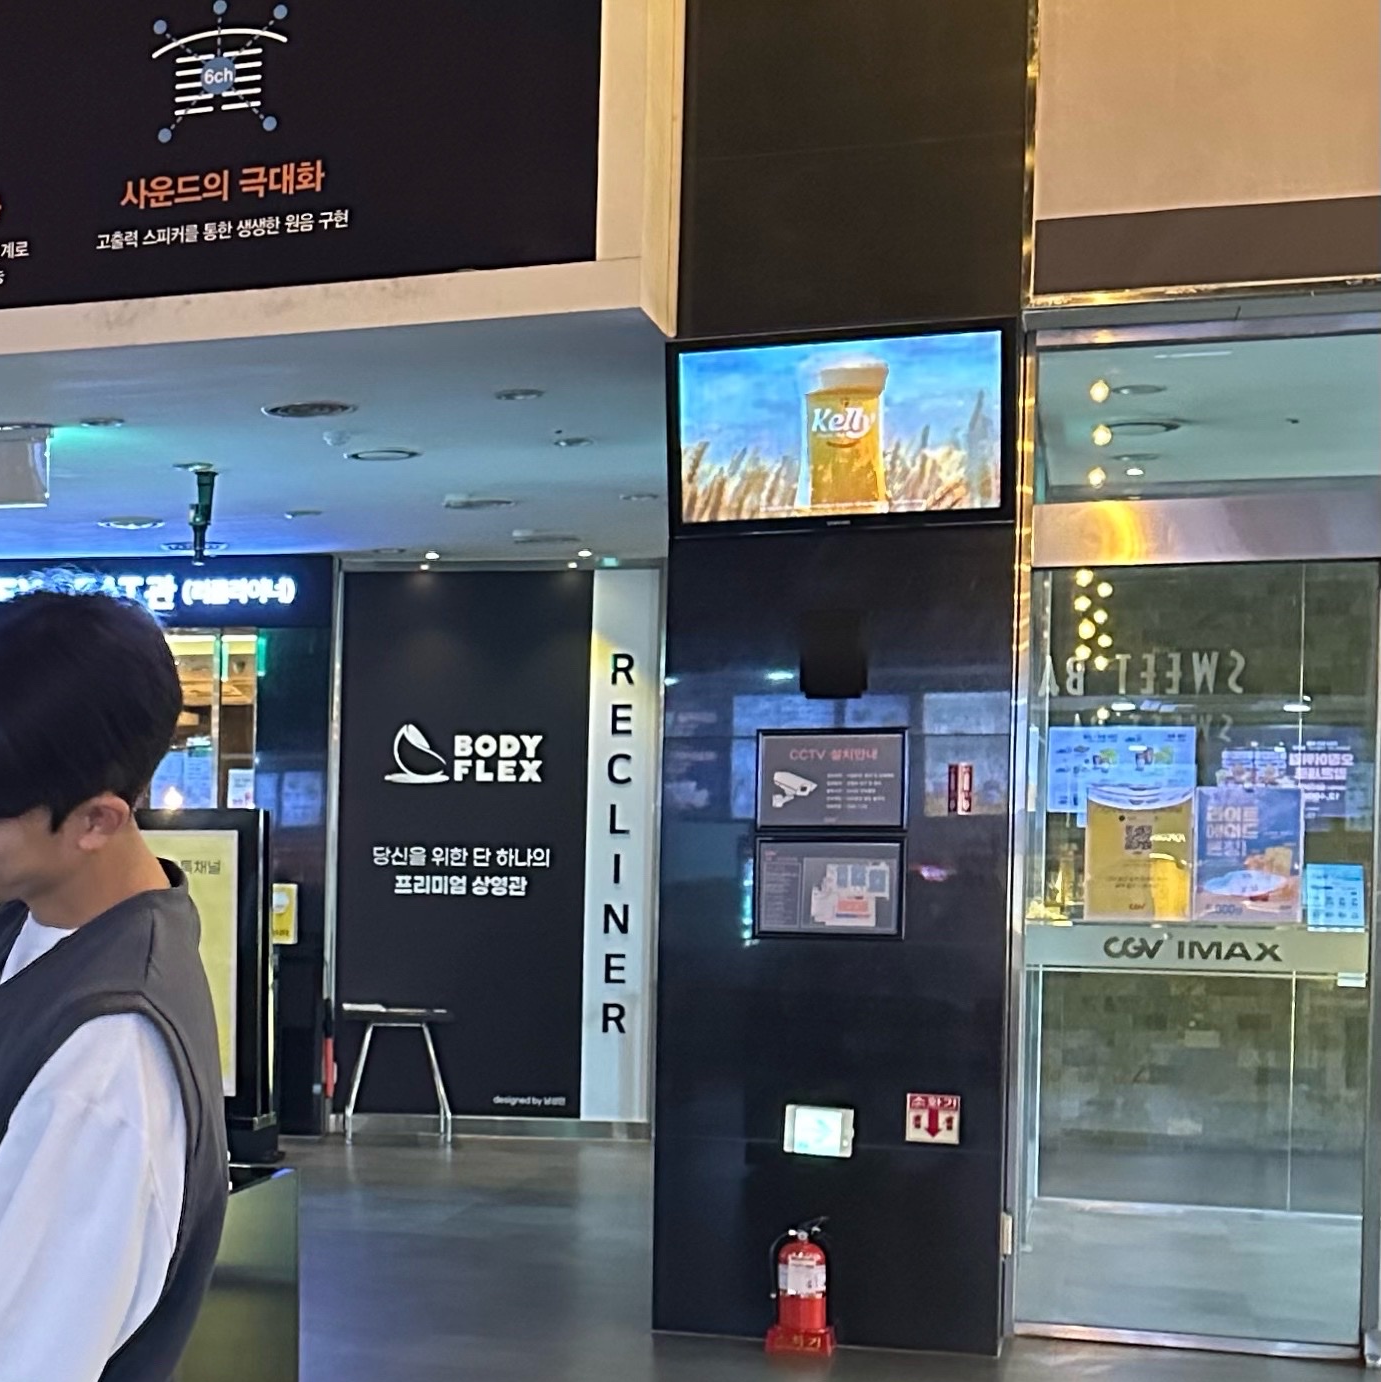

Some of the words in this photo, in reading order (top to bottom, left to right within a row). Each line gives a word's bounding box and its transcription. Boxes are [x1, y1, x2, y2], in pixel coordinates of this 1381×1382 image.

[203, 66, 234, 85] 6ch
[120, 169, 229, 209] 사운드의
[239, 159, 325, 198] 극대화
[96, 230, 138, 250] 고출력
[142, 224, 198, 246] 스피커를
[203, 221, 233, 242] 통한
[236, 216, 280, 238] 생생한
[285, 213, 315, 233] 원음
[318, 209, 349, 229] 구현
[811, 406, 875, 438] Kelly
[454, 734, 543, 758] BODY
[789, 749, 826, 760] CCTV
[454, 759, 543, 782] FLEX
[602, 652, 635, 1035] RECLINER
[373, 846, 426, 867] 당신을
[431, 846, 468, 867] 위한
[473, 847, 492, 867] 단
[496, 847, 550, 868] 하나의
[394, 875, 467, 895] 프리미엄
[472, 876, 528, 897] 상영관
[1104, 936, 1165, 960] CGV
[1177, 940, 1283, 962] IMAX
